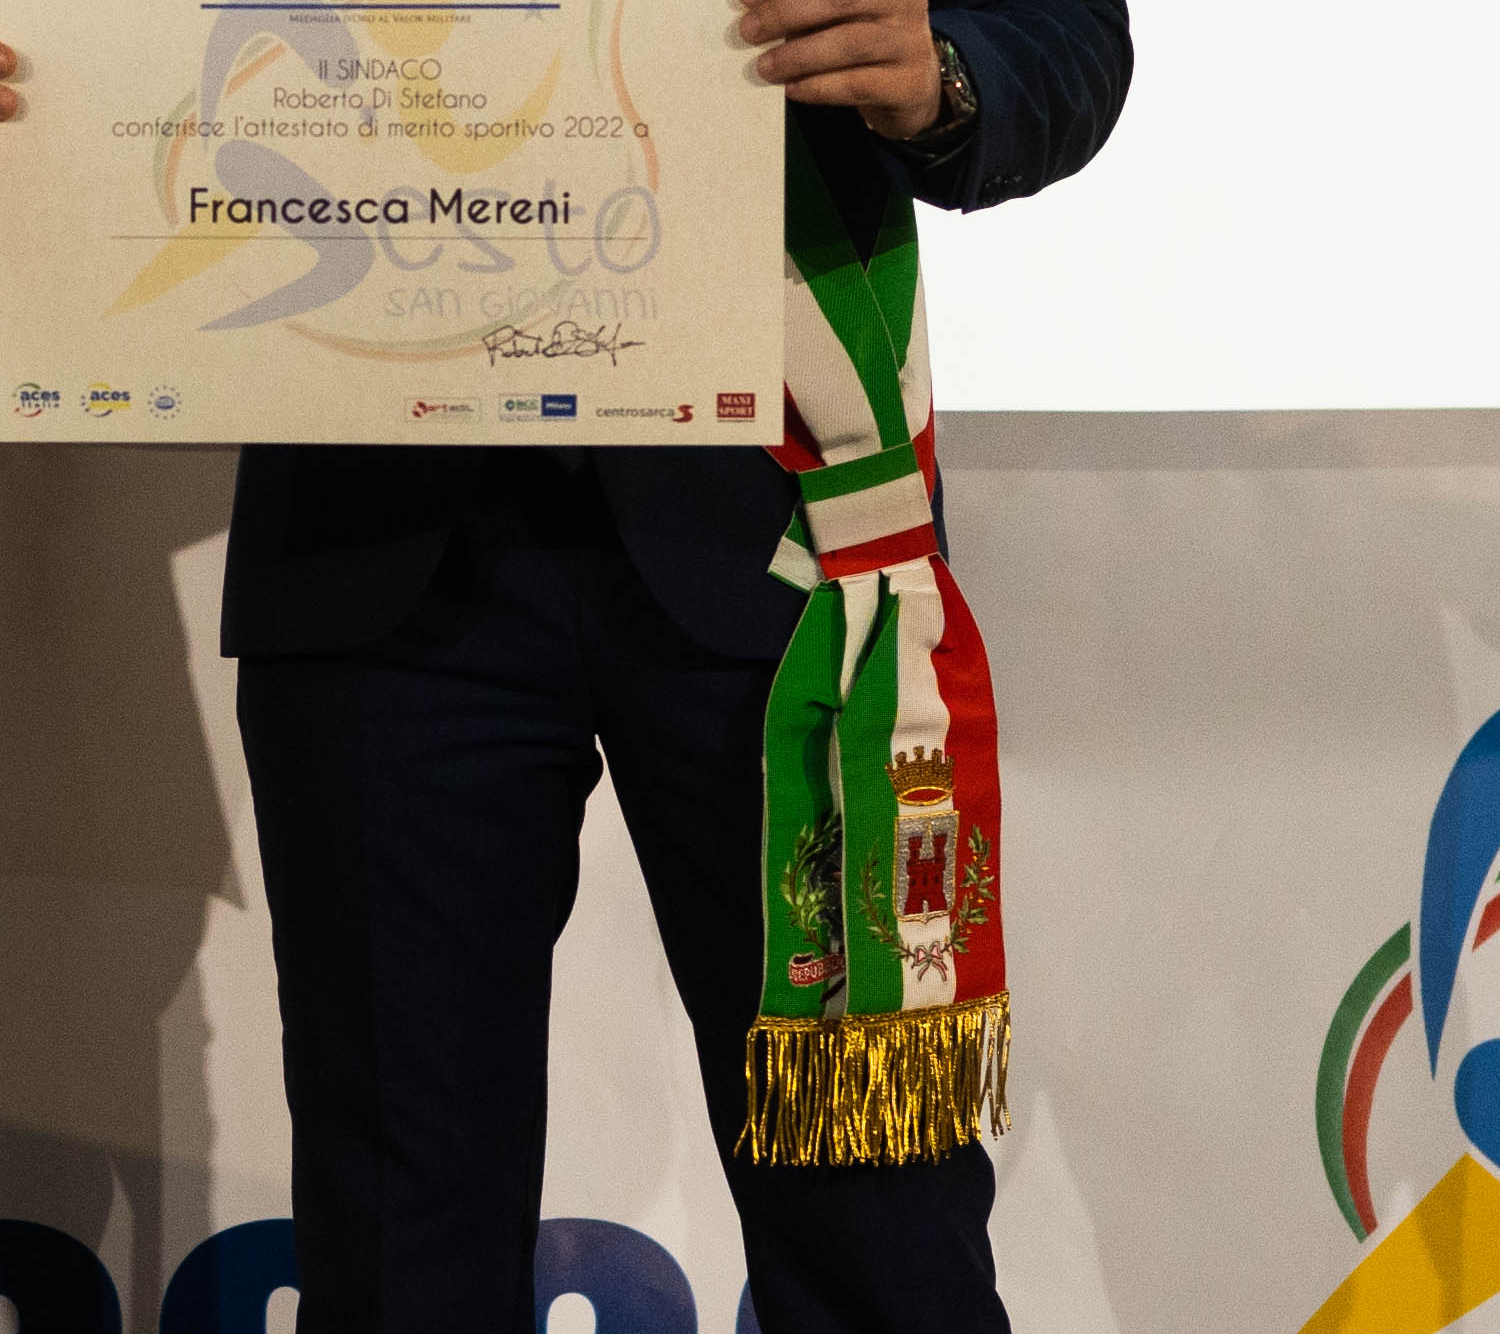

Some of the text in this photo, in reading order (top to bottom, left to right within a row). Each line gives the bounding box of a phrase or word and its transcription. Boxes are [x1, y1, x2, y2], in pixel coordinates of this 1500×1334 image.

[337, 59, 442, 80] SINDACO
[273, 87, 487, 109] Roberto Di Stefano
[111, 116, 649, 141] conferisce l'attestato di merito sportivo 2022 a
[190, 187, 571, 224] Francesca Mereni
[20, 390, 61, 401] aces
[90, 390, 131, 401] aces
